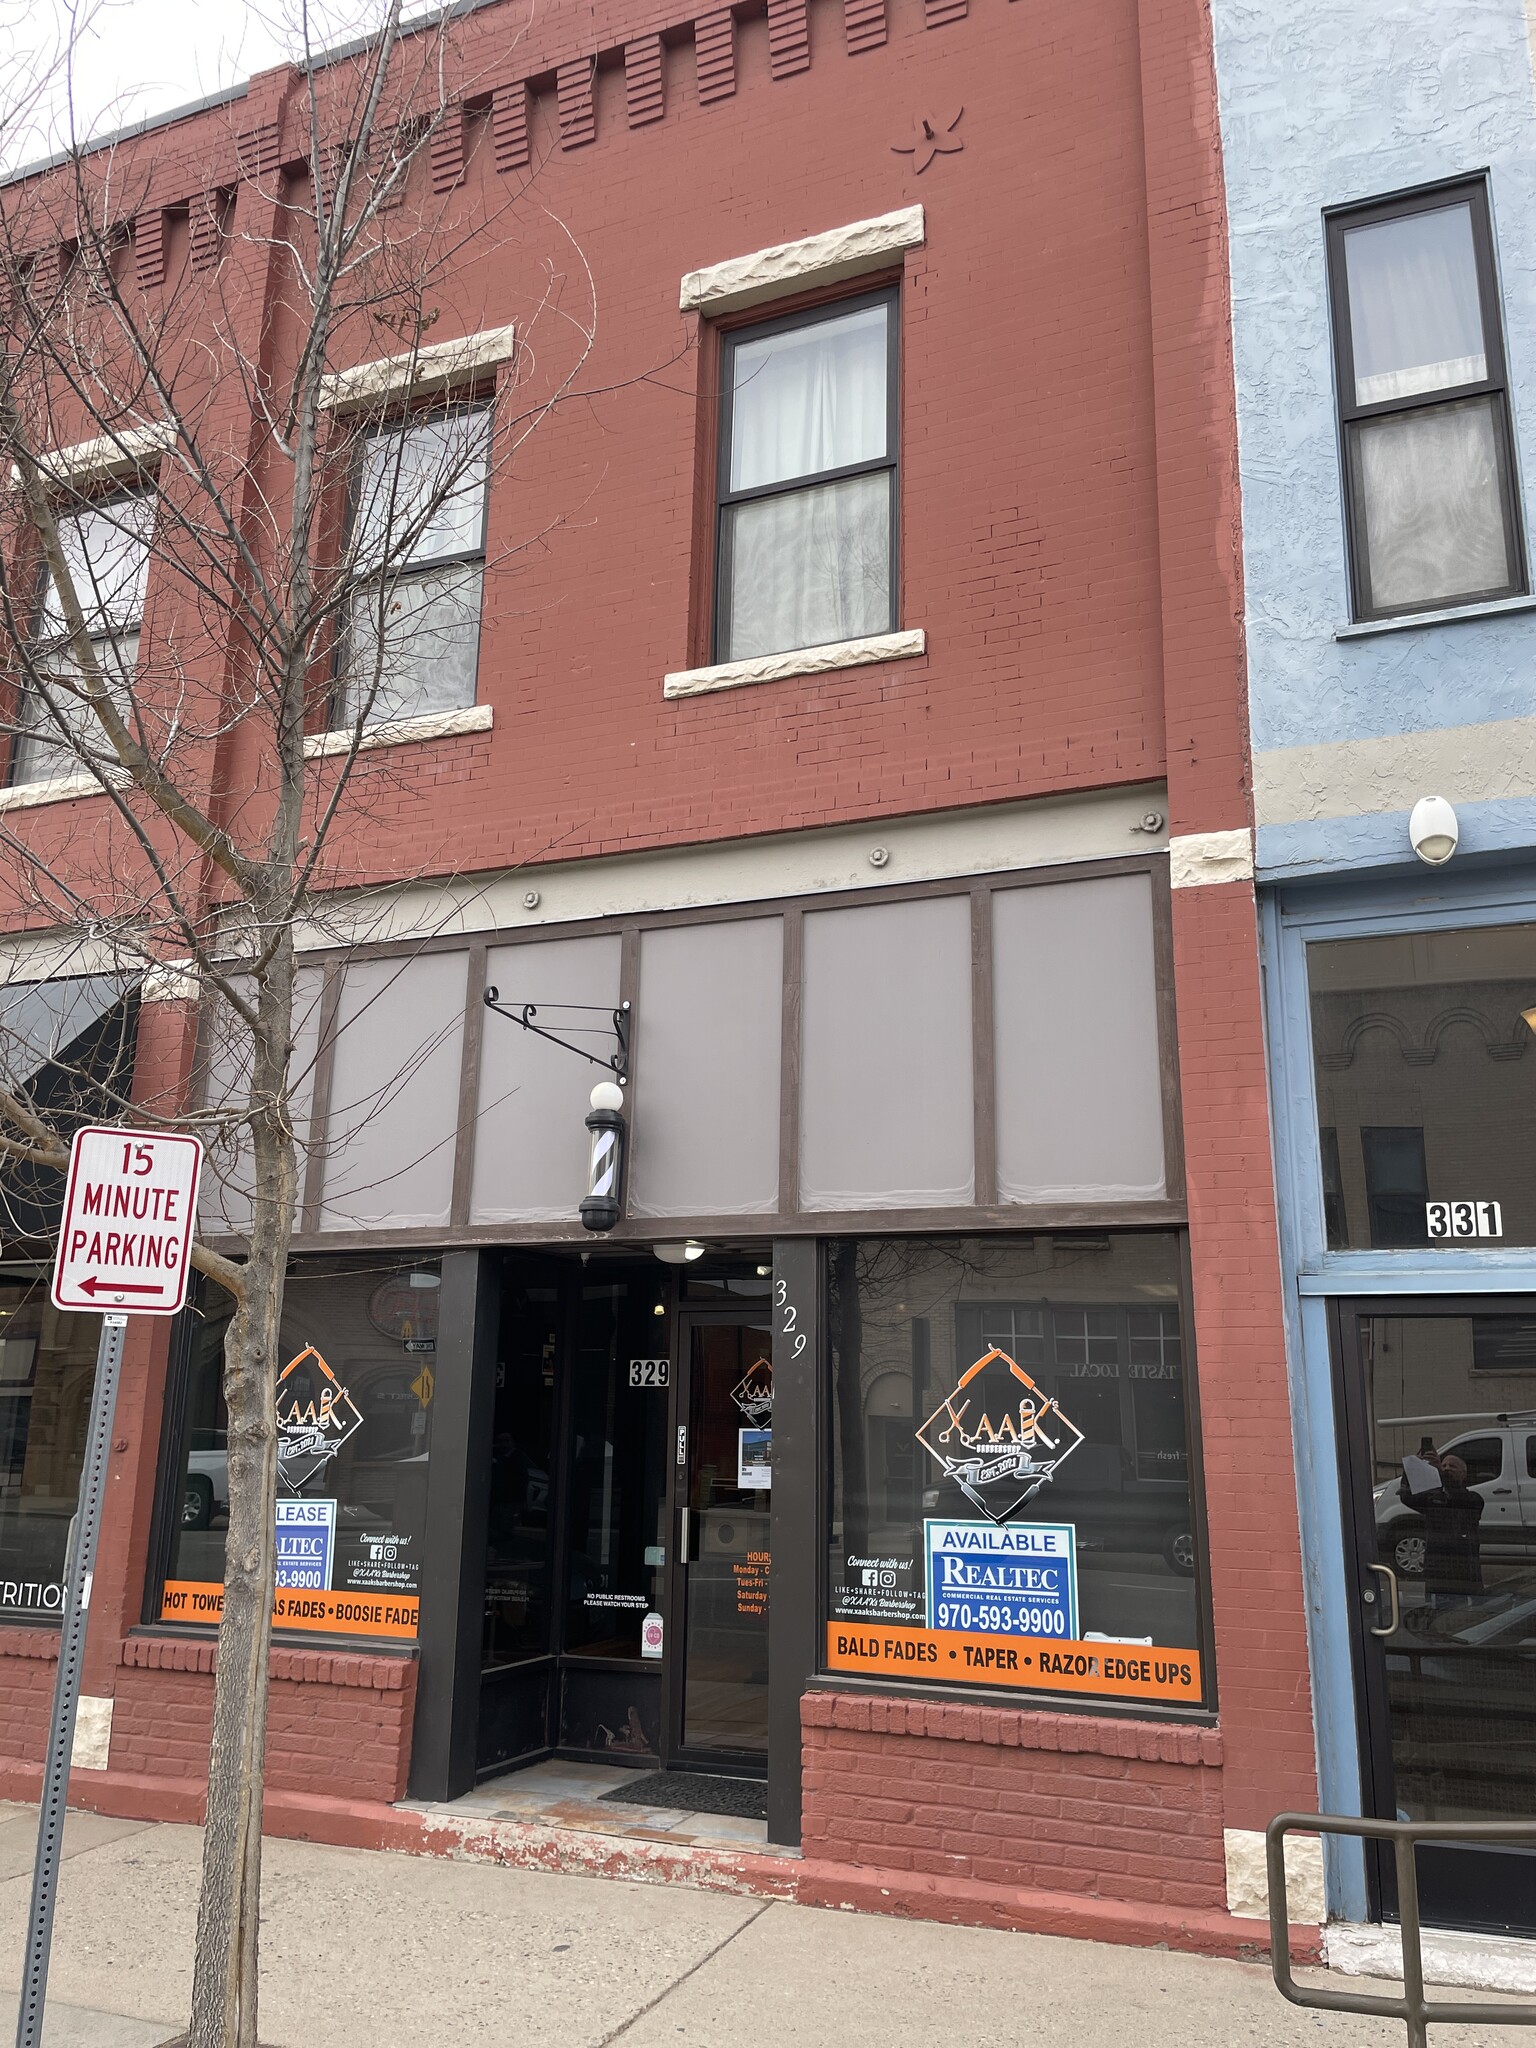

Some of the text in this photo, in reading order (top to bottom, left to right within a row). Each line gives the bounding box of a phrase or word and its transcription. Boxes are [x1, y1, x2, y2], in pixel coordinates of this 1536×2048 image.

[122, 1143, 154, 1176] 15
[82, 1183, 180, 1222] MINUTE
[1429, 1204, 1497, 1237] 331
[70, 1230, 179, 1269] PARKING
[631, 1361, 669, 1386] 329
[276, 1507, 327, 1522] LEASE
[360, 1532, 412, 1545] Connect with us!
[942, 1532, 1056, 1552] AVAILABLE
[747, 1552, 771, 1563] HOUR
[848, 1555, 914, 1570] Connect with us!
[733, 1565, 759, 1576] Monday
[347, 1579, 417, 1589] www.xaaksbarbershop.com
[737, 1578, 764, 1587] Tues-Fri
[737, 1590, 767, 1602] Saturday
[164, 1592, 188, 1609] HOT
[192, 1593, 224, 1611] TOWE
[288, 1600, 325, 1618] FADES
[336, 1603, 382, 1623] BOOSIE
[385, 1607, 419, 1626] FADE
[738, 1603, 763, 1615] Sunday
[879, 1598, 916, 1611] Barbershop
[835, 1607, 926, 1620] www.xaaksbarbershop.com
[938, 1603, 1065, 1635] 970-593-9900
[838, 1636, 1192, 1686] BALD FADES TAPER RAZOR EDGE UPS
